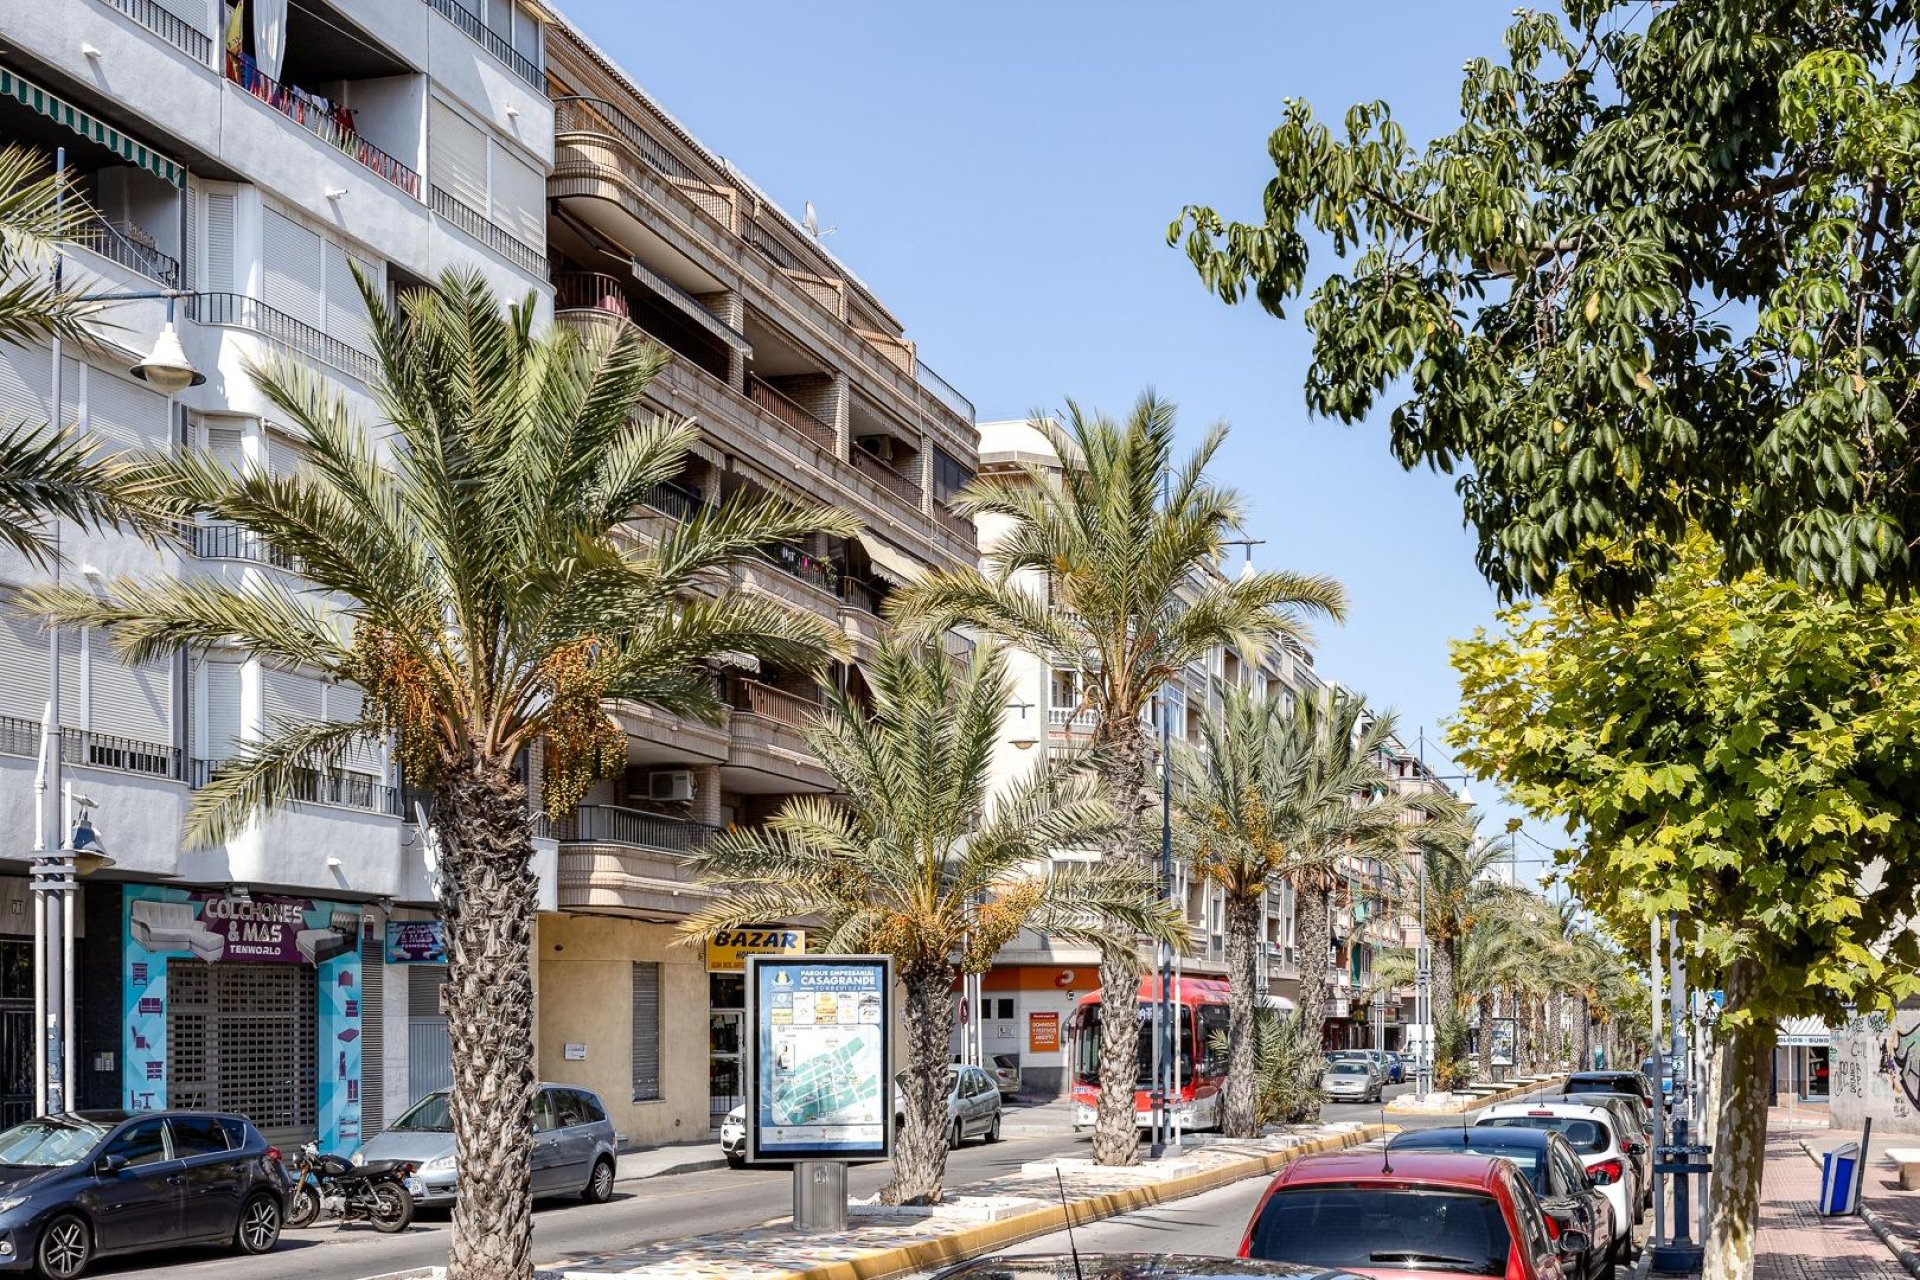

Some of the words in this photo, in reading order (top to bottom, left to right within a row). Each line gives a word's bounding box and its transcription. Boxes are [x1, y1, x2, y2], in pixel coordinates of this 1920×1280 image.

[205, 898, 303, 923] COLCHONES
[228, 921, 240, 942] &
[243, 922, 282, 943] MAS
[714, 931, 798, 949] BAZAR
[230, 945, 282, 955] TENWORLD
[830, 969, 875, 977] EMPRESARIAL
[800, 976, 876, 986] CASAGRANDE
